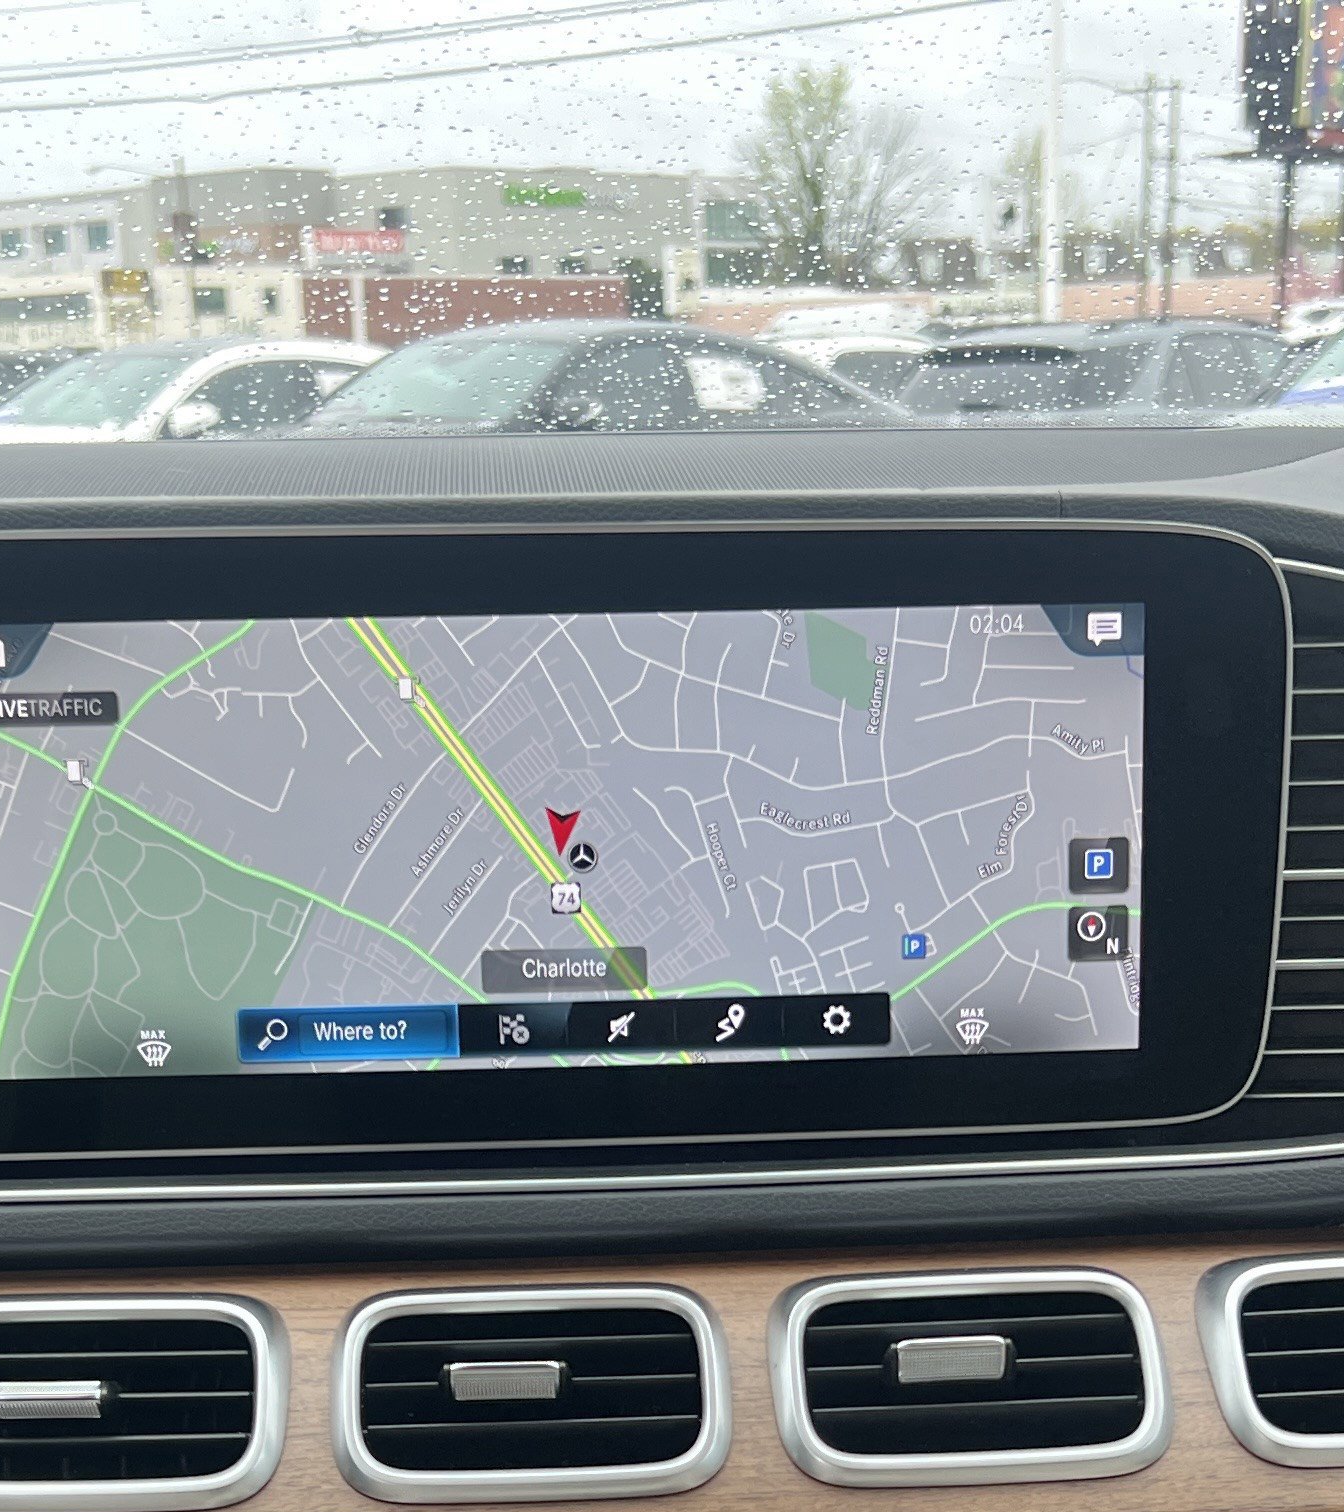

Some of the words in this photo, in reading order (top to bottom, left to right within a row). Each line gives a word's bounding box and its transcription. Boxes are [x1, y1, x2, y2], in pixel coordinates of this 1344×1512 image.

[969, 614, 1024, 634] 02:04
[781, 631, 796, 649] Dr
[874, 646, 889, 666] Rd
[865, 669, 886, 735] Reddman
[1052, 724, 1089, 755] Amity
[1092, 739, 1105, 751] Pl
[353, 800, 397, 854] Glendora
[390, 782, 407, 801] Dr
[760, 802, 829, 831] Eaglecrest
[832, 810, 851, 826] Rd
[410, 824, 454, 877] Ashmore
[447, 807, 465, 825] Dr
[977, 861, 1003, 879] Elm
[995, 810, 1022, 856] Forest
[1016, 794, 1028, 812] Dr
[706, 822, 729, 871] Hooper
[722, 873, 737, 890] Ct
[442, 876, 476, 916] Jerilyn
[470, 859, 488, 876] Dr
[558, 892, 576, 906] 74
[1106, 937, 1120, 954] N
[522, 958, 606, 979] Charlotte
[959, 1007, 984, 1018] MAX
[140, 1030, 166, 1040] MAX
[313, 1021, 373, 1041] Where
[379, 1020, 407, 1040] to?
